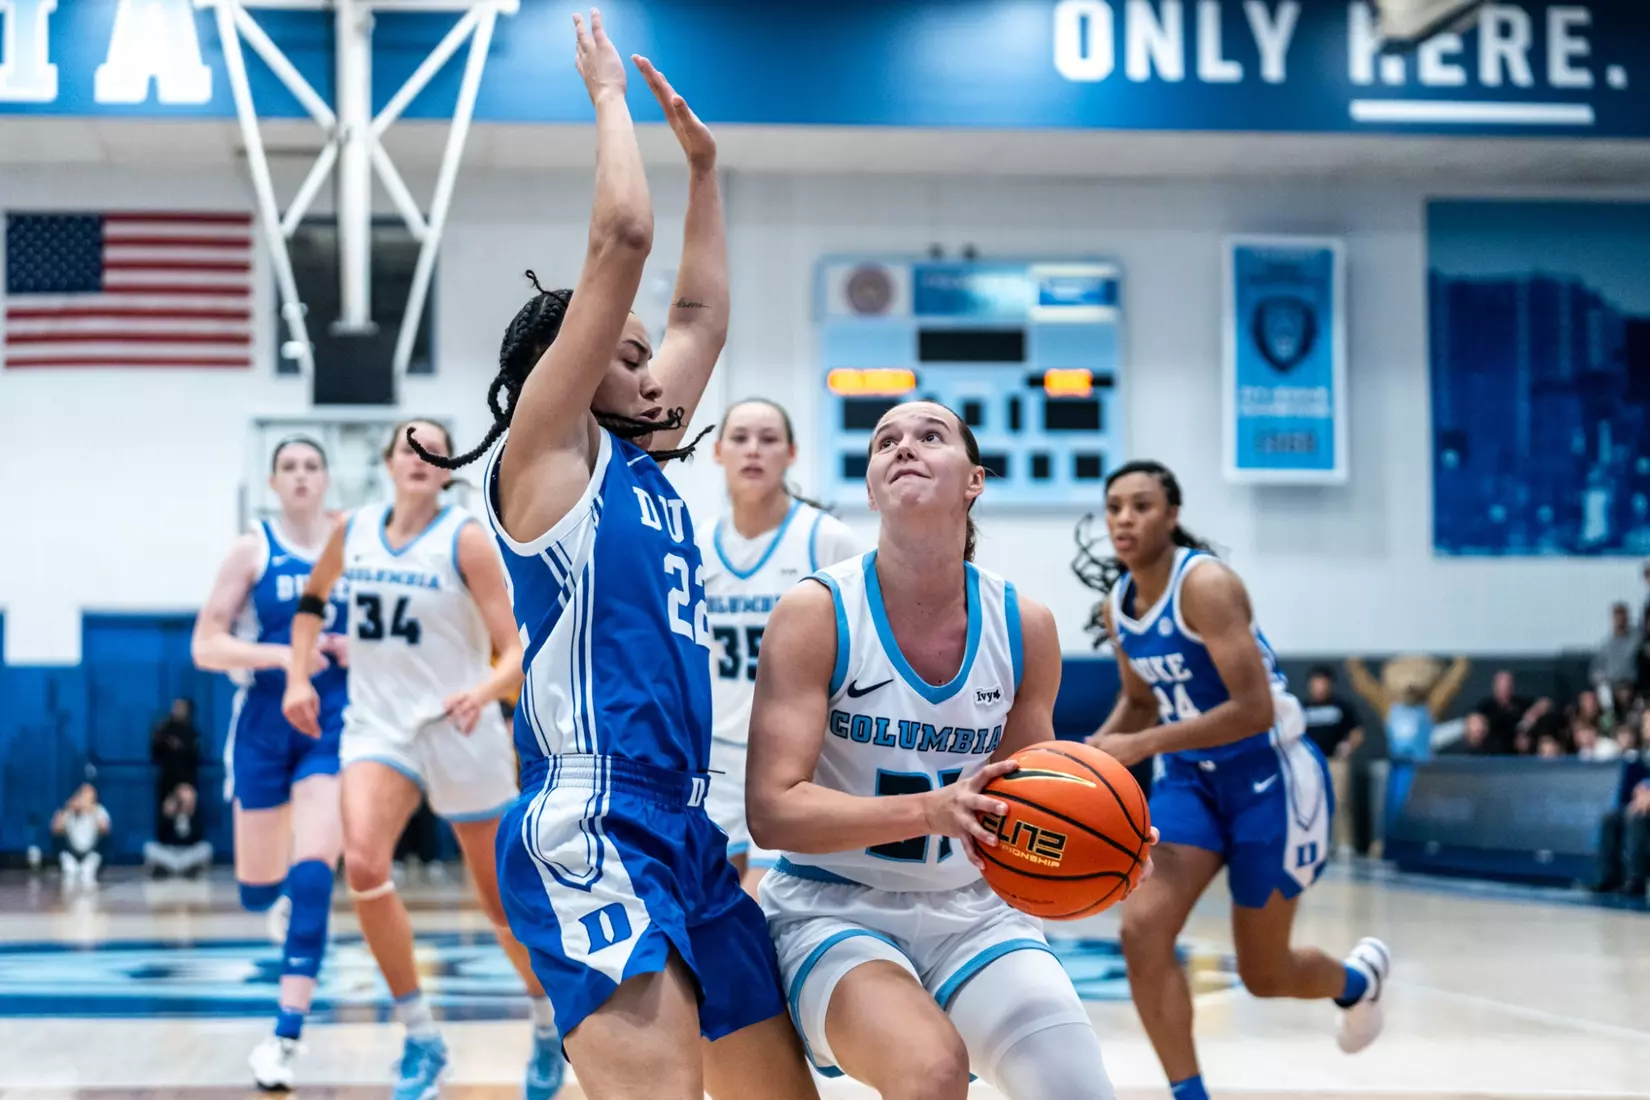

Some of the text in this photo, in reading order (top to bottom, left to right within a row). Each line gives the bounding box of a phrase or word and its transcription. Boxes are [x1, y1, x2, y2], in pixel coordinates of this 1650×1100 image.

[1053, 0, 1300, 84] ONLY
[355, 593, 423, 646] 34
[712, 625, 765, 681] 35
[976, 691, 993, 702] Ivy
[829, 709, 1002, 754] COLUMBIA
[578, 902, 632, 954] D
